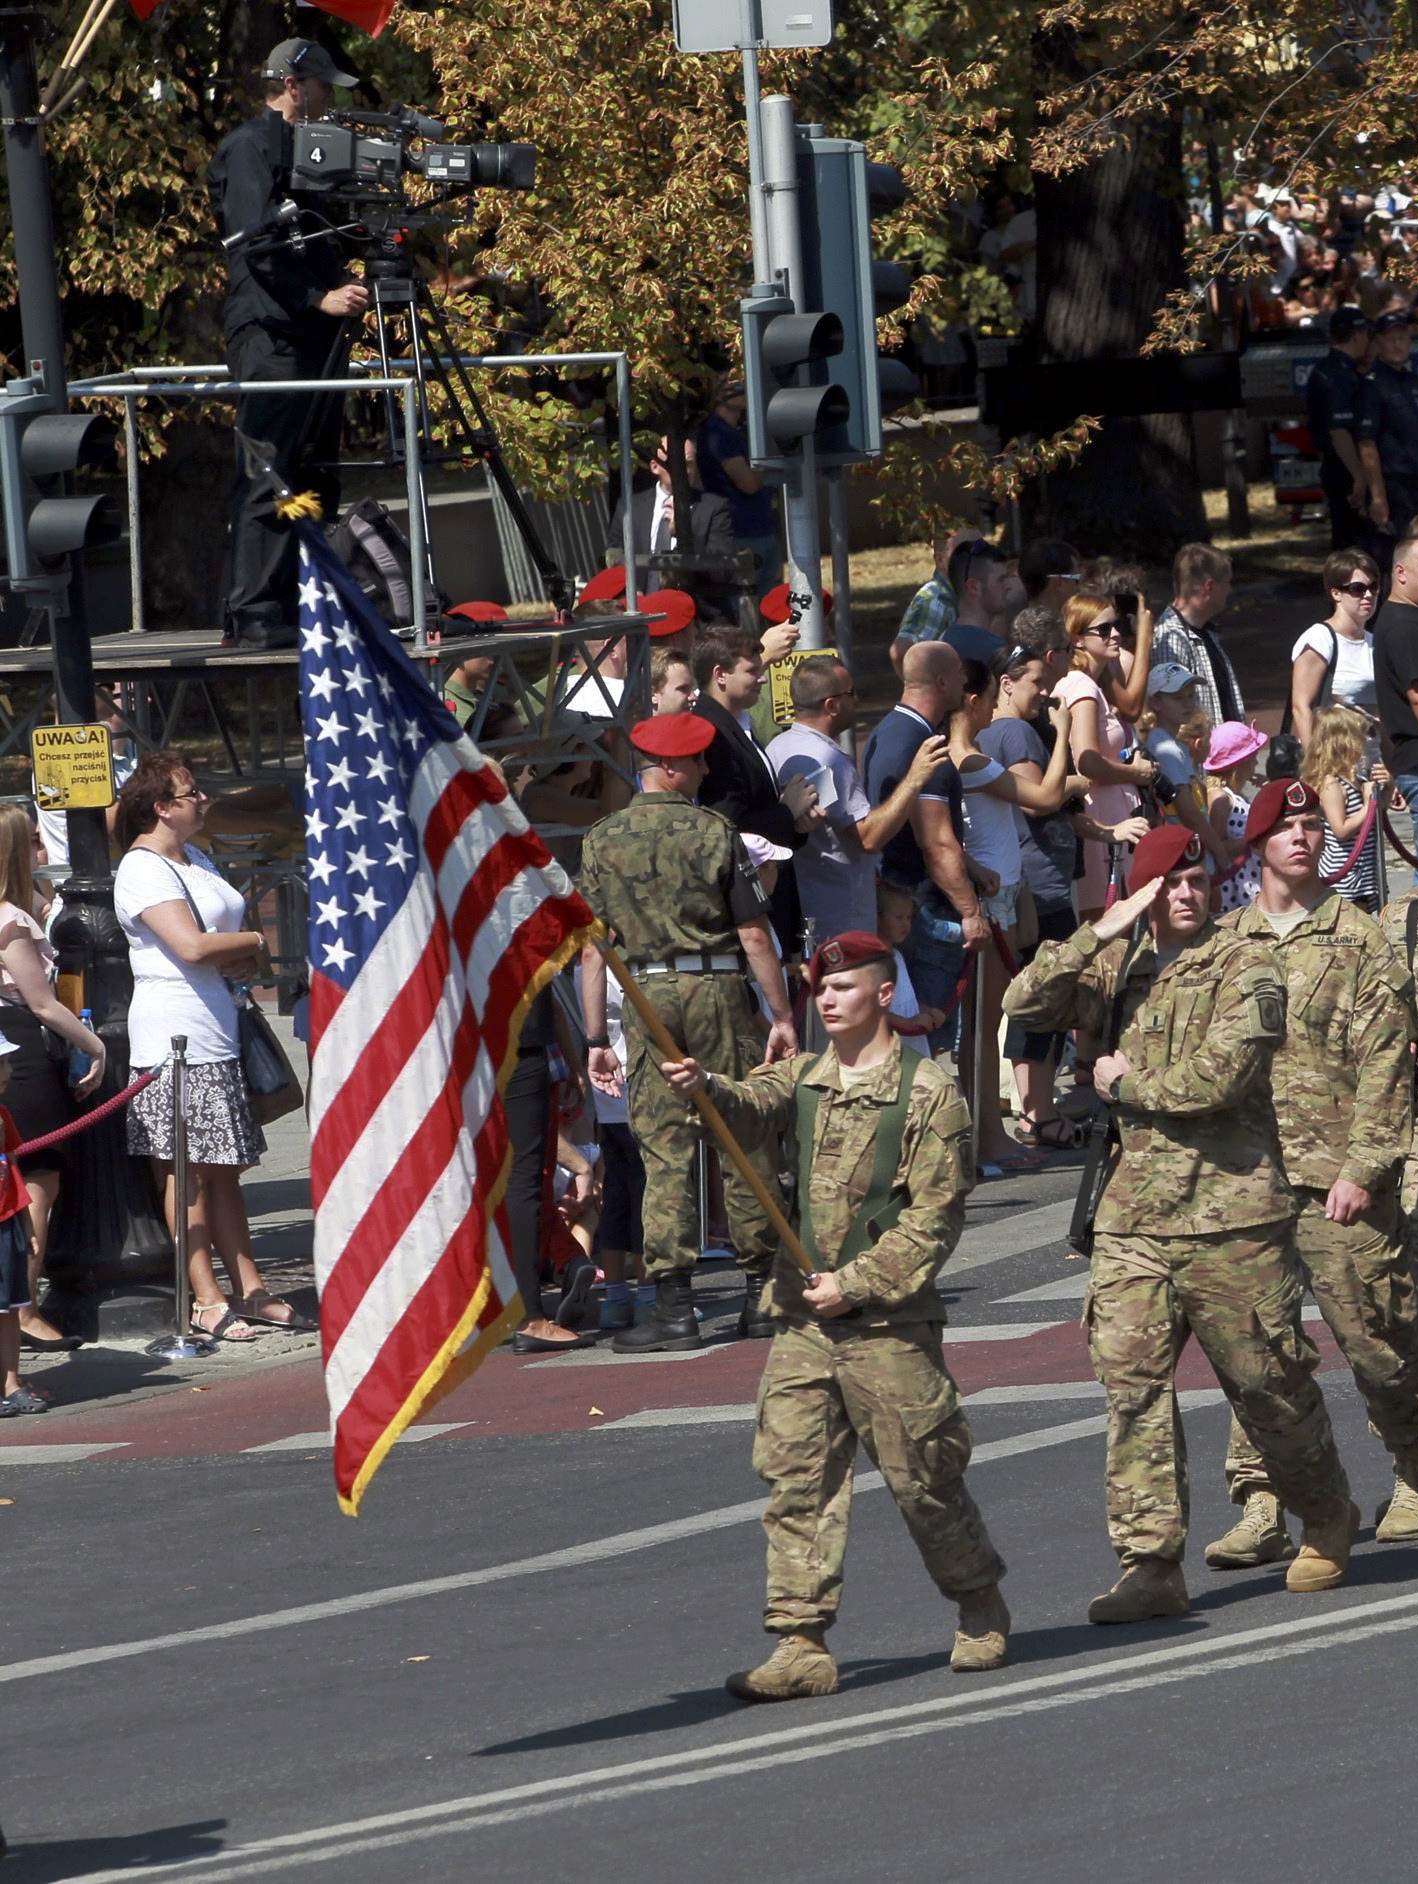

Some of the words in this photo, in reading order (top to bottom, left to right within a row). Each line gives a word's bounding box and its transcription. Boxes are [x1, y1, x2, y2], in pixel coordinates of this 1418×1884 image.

[310, 147, 322, 163] 4
[39, 751, 71, 761] Chcesz
[74, 750, 105, 760] przejść
[73, 762, 107, 771] naciśnij
[71, 774, 107, 785] przycisk
